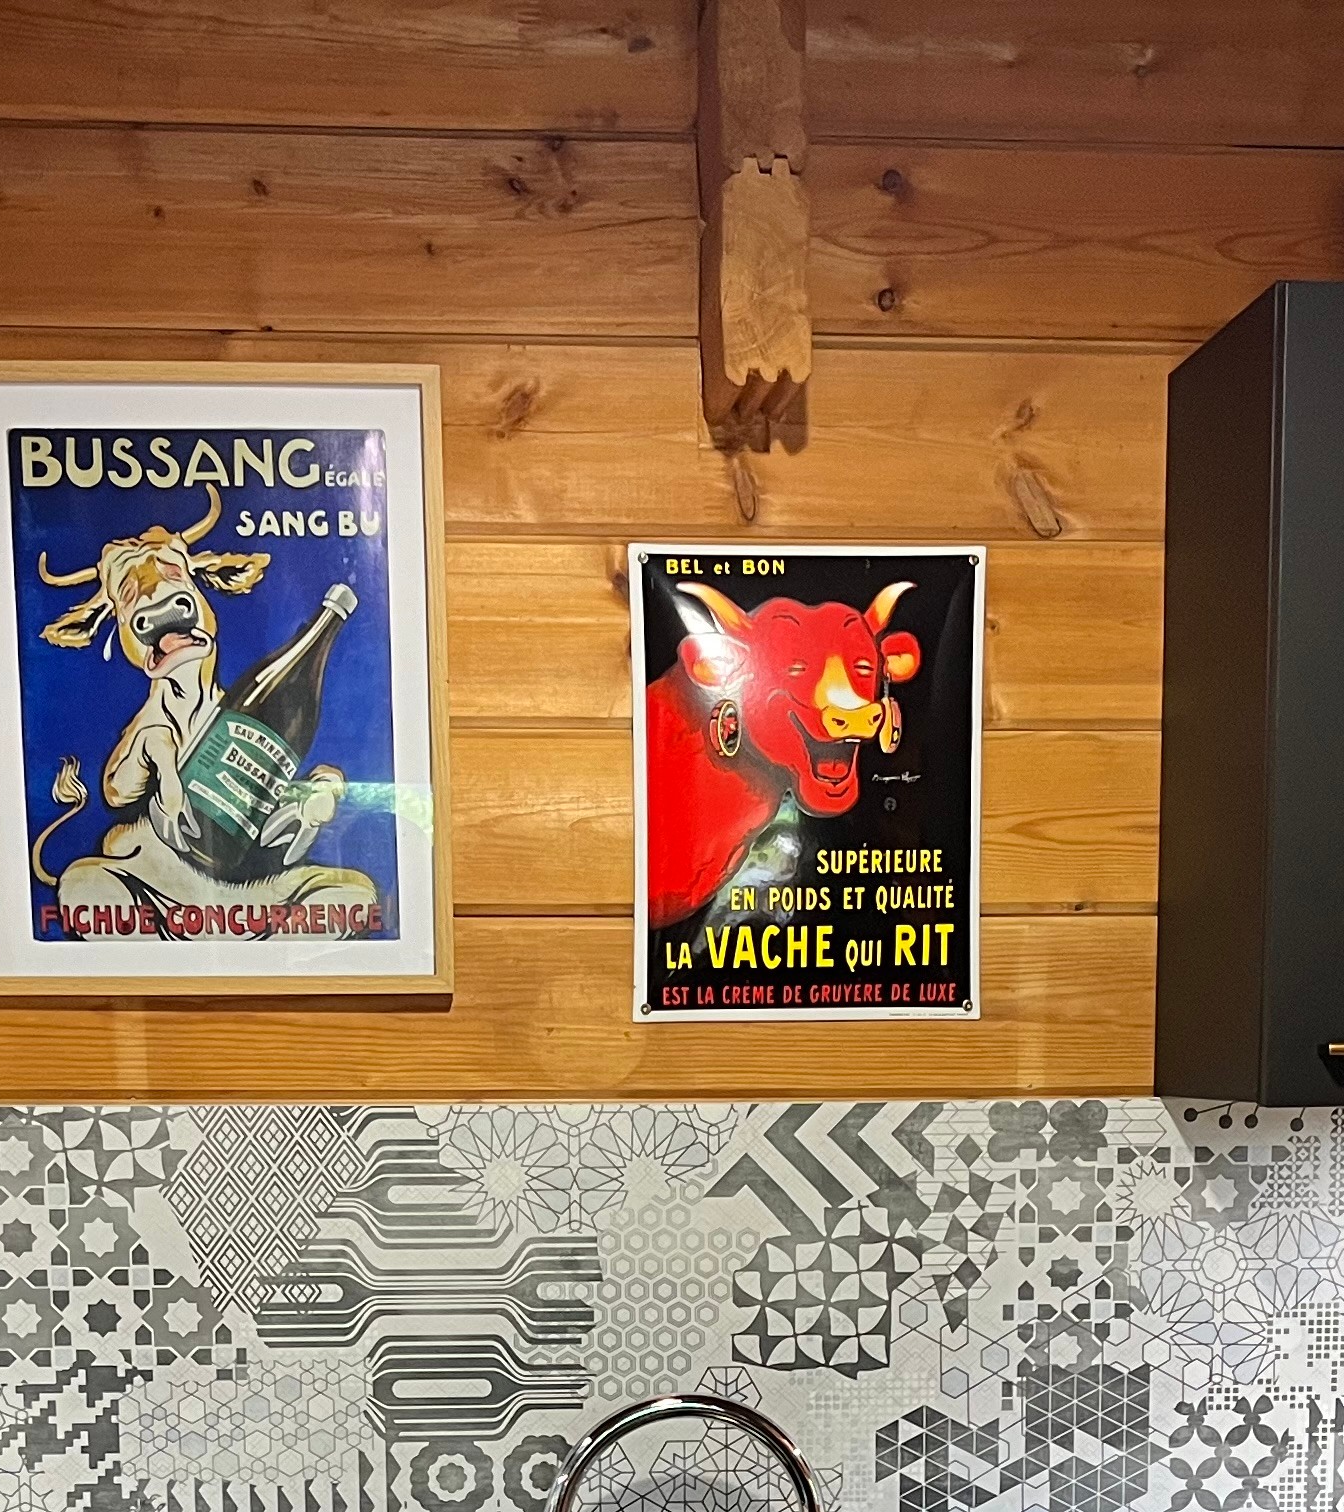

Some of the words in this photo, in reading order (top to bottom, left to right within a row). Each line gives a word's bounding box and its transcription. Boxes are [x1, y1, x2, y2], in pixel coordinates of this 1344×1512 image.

[20, 436, 320, 488] BUSSANG
[235, 510, 329, 537] SANG
[338, 510, 381, 537] BU
[666, 558, 704, 575] BEL
[713, 561, 731, 575] et
[742, 558, 785, 576] BON
[234, 725, 255, 740] EAU
[226, 747, 285, 798] BUSSANG
[816, 842, 943, 875] SUPÉRIEURE
[730, 886, 755, 911] EN
[769, 886, 831, 911] POIDS
[843, 887, 866, 910] ET
[875, 878, 955, 914] QUALITÉ
[40, 904, 156, 935] FICHUE
[166, 903, 384, 936] CONCURRENCE
[666, 942, 693, 970] LA
[705, 924, 835, 970] VACHE
[845, 938, 882, 972] QUI
[894, 923, 955, 967] RIT
[663, 986, 690, 1006] EST
[697, 985, 715, 1005] LA
[783, 985, 803, 1004] DE
[890, 983, 911, 1002] DE
[919, 982, 956, 1002] LUXE
